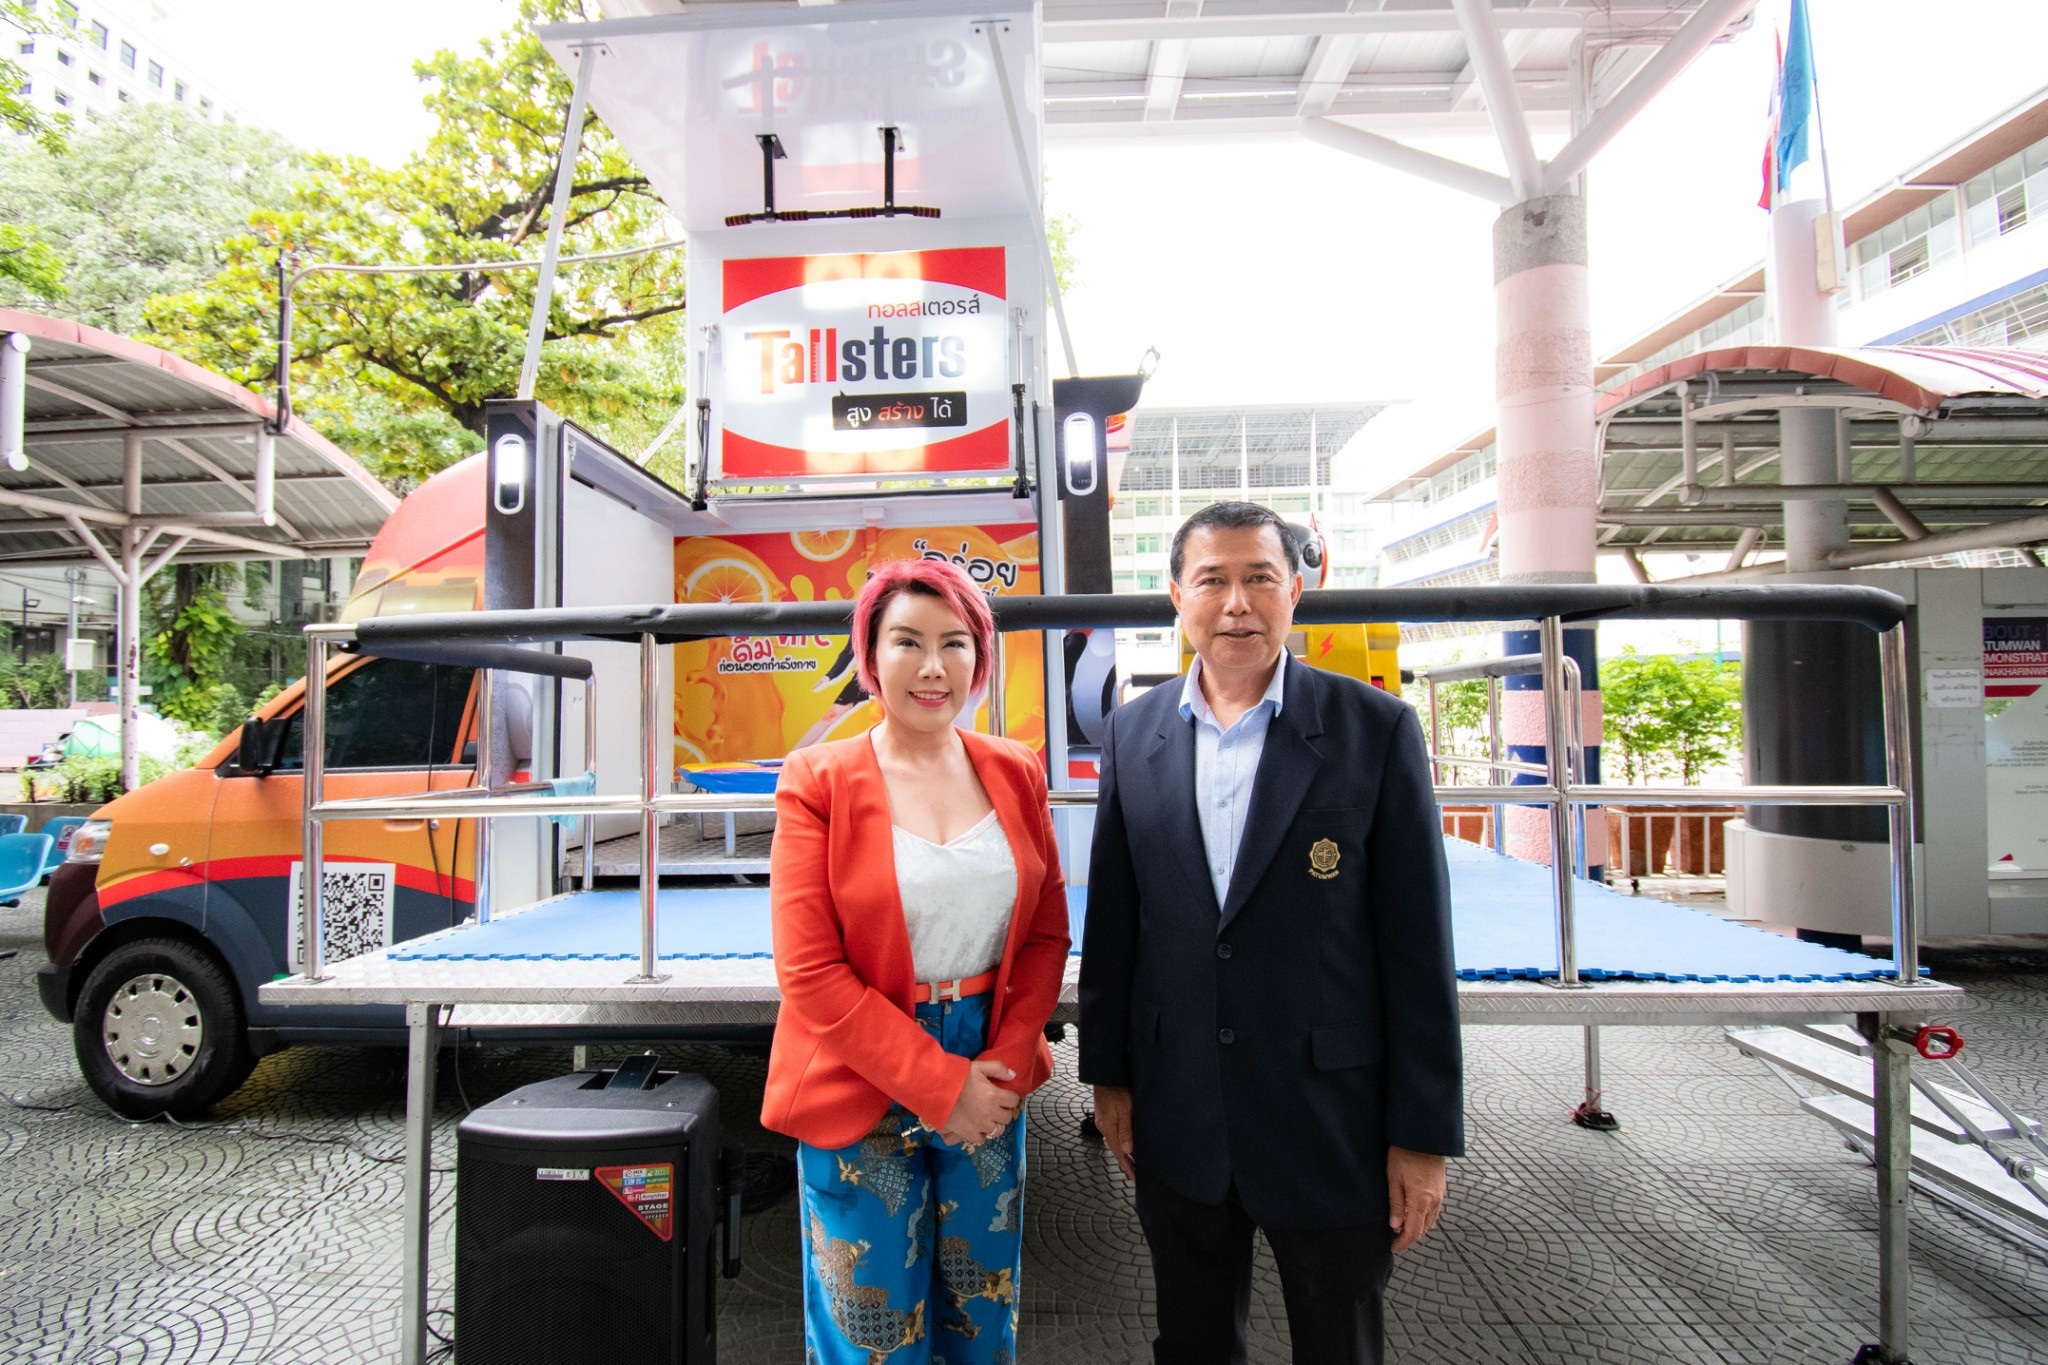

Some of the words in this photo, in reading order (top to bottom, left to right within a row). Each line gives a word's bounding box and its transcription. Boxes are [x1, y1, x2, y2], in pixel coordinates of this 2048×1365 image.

[743, 325, 966, 395] Tallsters
[846, 404, 872, 428] สูง
[877, 404, 925, 422] สร้าง
[930, 396, 952, 419] ได้
[1983, 640, 2041, 651] TUMWAN
[719, 656, 817, 673] ก่อนออกกำลังกาย
